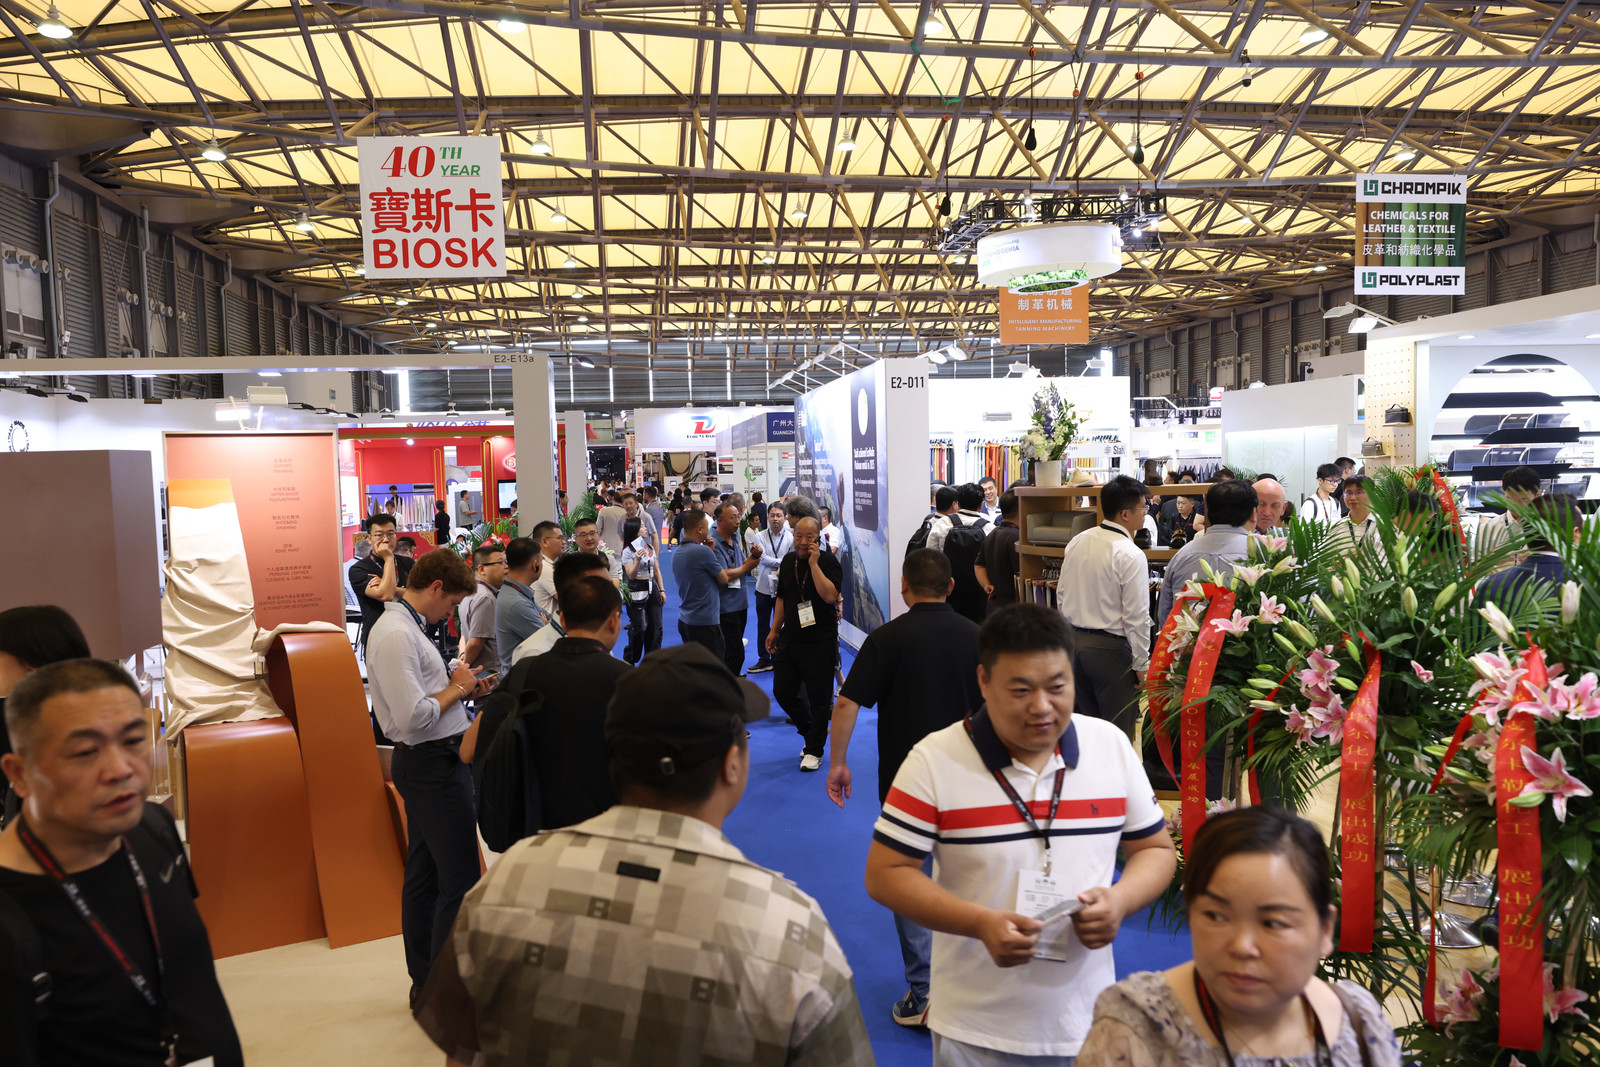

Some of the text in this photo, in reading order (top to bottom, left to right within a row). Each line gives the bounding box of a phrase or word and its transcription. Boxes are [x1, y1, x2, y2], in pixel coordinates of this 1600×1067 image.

[380, 146, 462, 177] 40 TH
[440, 164, 481, 176] YEAR
[1381, 182, 1462, 195] CHROMPIK
[368, 186, 496, 234] 寶斯卡
[1370, 211, 1449, 221] CHEMICALS FOR
[1363, 223, 1456, 233] LEATHER & TEXTILE
[372, 237, 498, 269] BIOSK
[1362, 243, 1456, 256] 皮革和紡織化學品
[1379, 274, 1461, 286] POLYPLAST
[1017, 298, 1073, 311] 制革机械
[494, 354, 534, 363] E2-E13a
[891, 376, 925, 389] E2-D11
[1343, 798, 1369, 863] 展出成功
